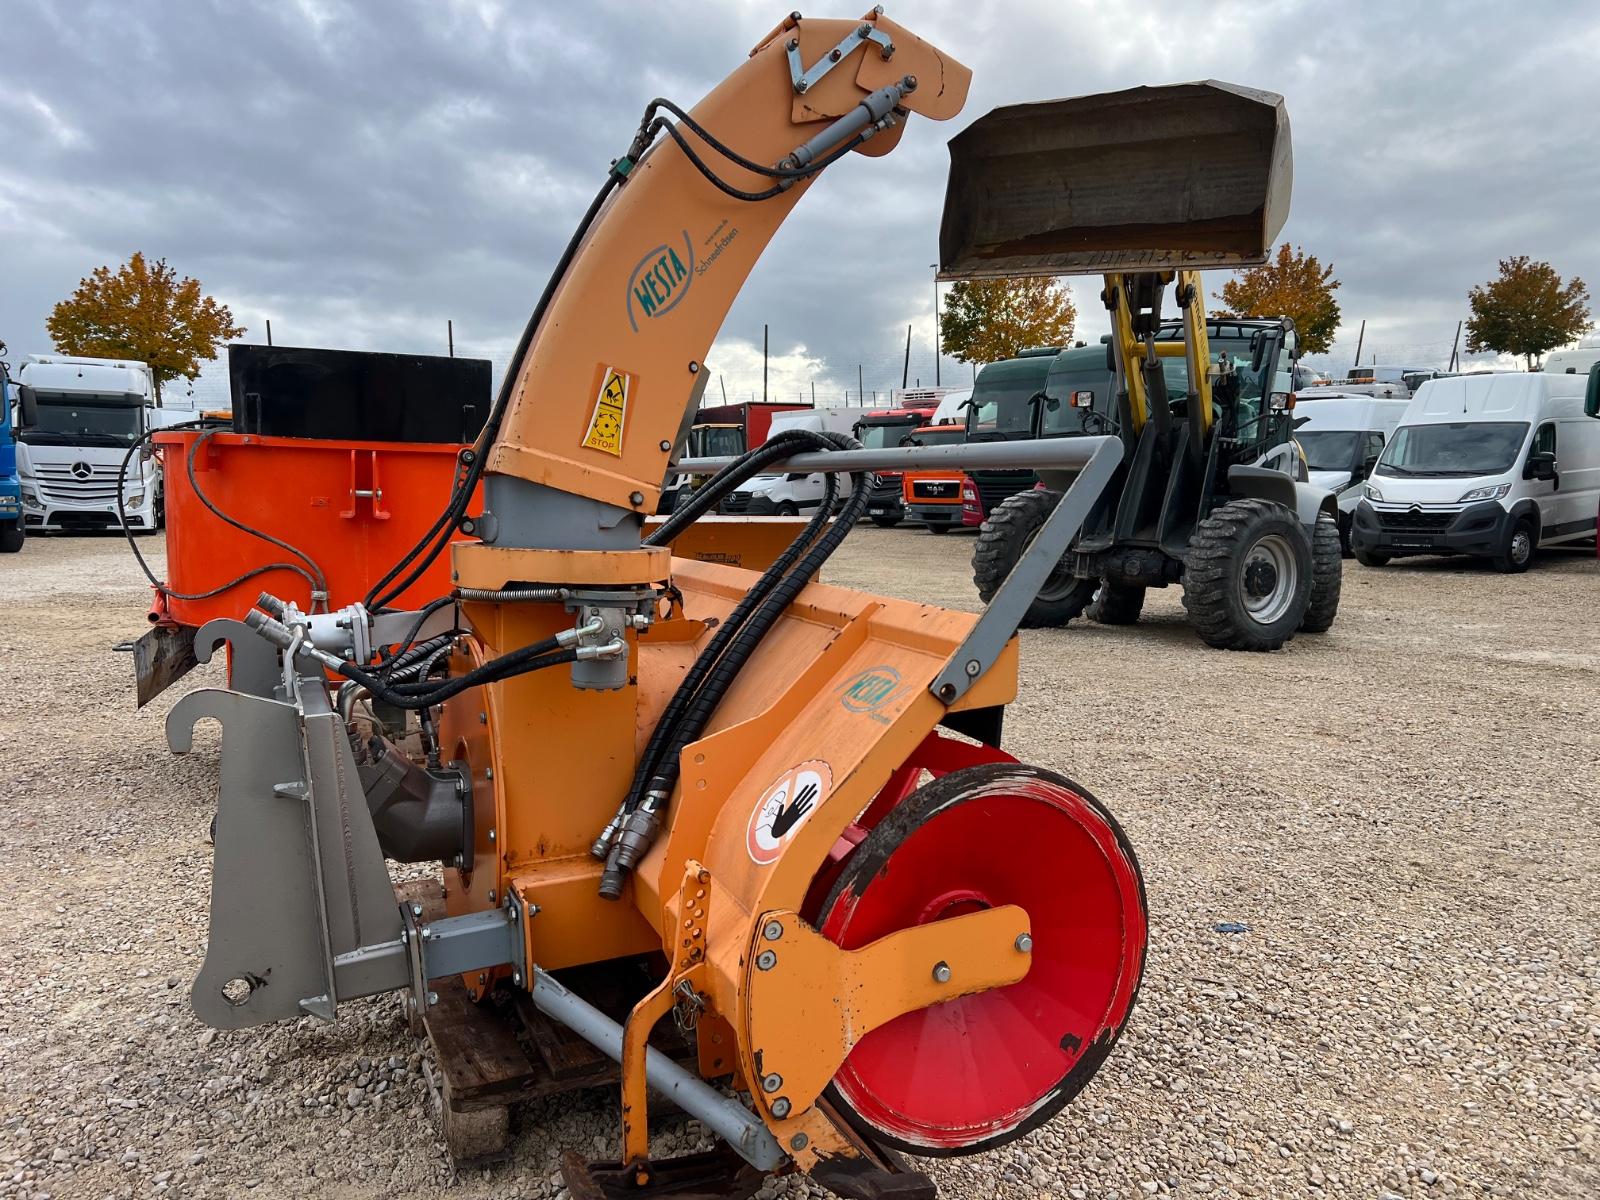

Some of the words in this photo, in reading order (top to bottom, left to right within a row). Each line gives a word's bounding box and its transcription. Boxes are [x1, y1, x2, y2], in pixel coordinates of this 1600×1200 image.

[695, 228, 738, 276] Schneefräsen
[633, 247, 687, 317] WESTA
[591, 437, 615, 449] STOP
[844, 672, 897, 706] WESTA
